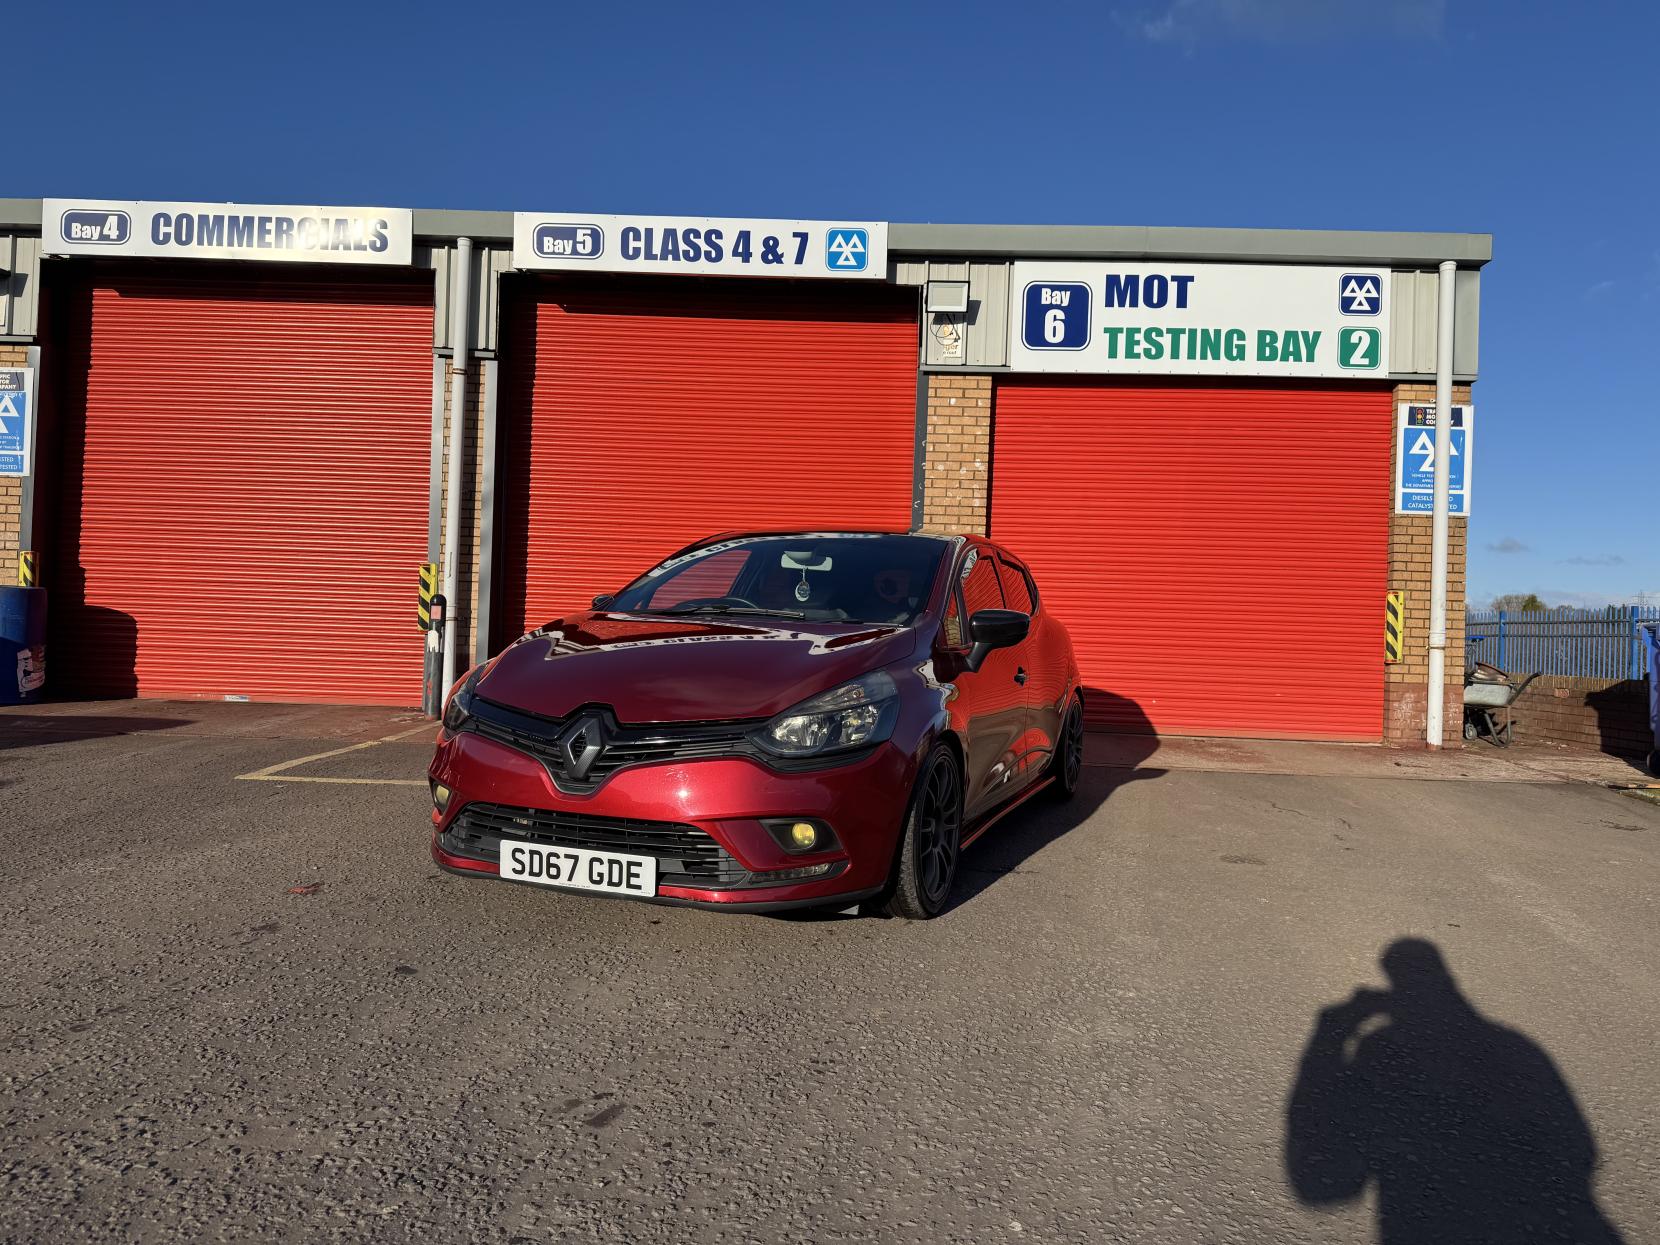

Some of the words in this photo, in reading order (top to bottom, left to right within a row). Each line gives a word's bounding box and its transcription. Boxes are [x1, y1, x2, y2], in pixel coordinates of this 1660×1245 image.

[71, 222, 101, 240] Bay
[102, 215, 119, 239] 4
[151, 212, 389, 252] COMMERCIALS
[543, 236, 573, 255] Bay
[576, 229, 592, 254] 5
[620, 226, 724, 263] CLASS
[732, 230, 753, 264] 4
[760, 235, 785, 265] &
[792, 232, 809, 265] 7
[1041, 287, 1071, 307] Bay
[1104, 274, 1195, 309] MOT
[1044, 309, 1065, 343] 6
[1103, 327, 1247, 362] TESTING
[1256, 330, 1322, 363] BAY
[1349, 331, 1370, 365] 2
[511, 847, 580, 882] SD67
[588, 856, 643, 891] GDE
